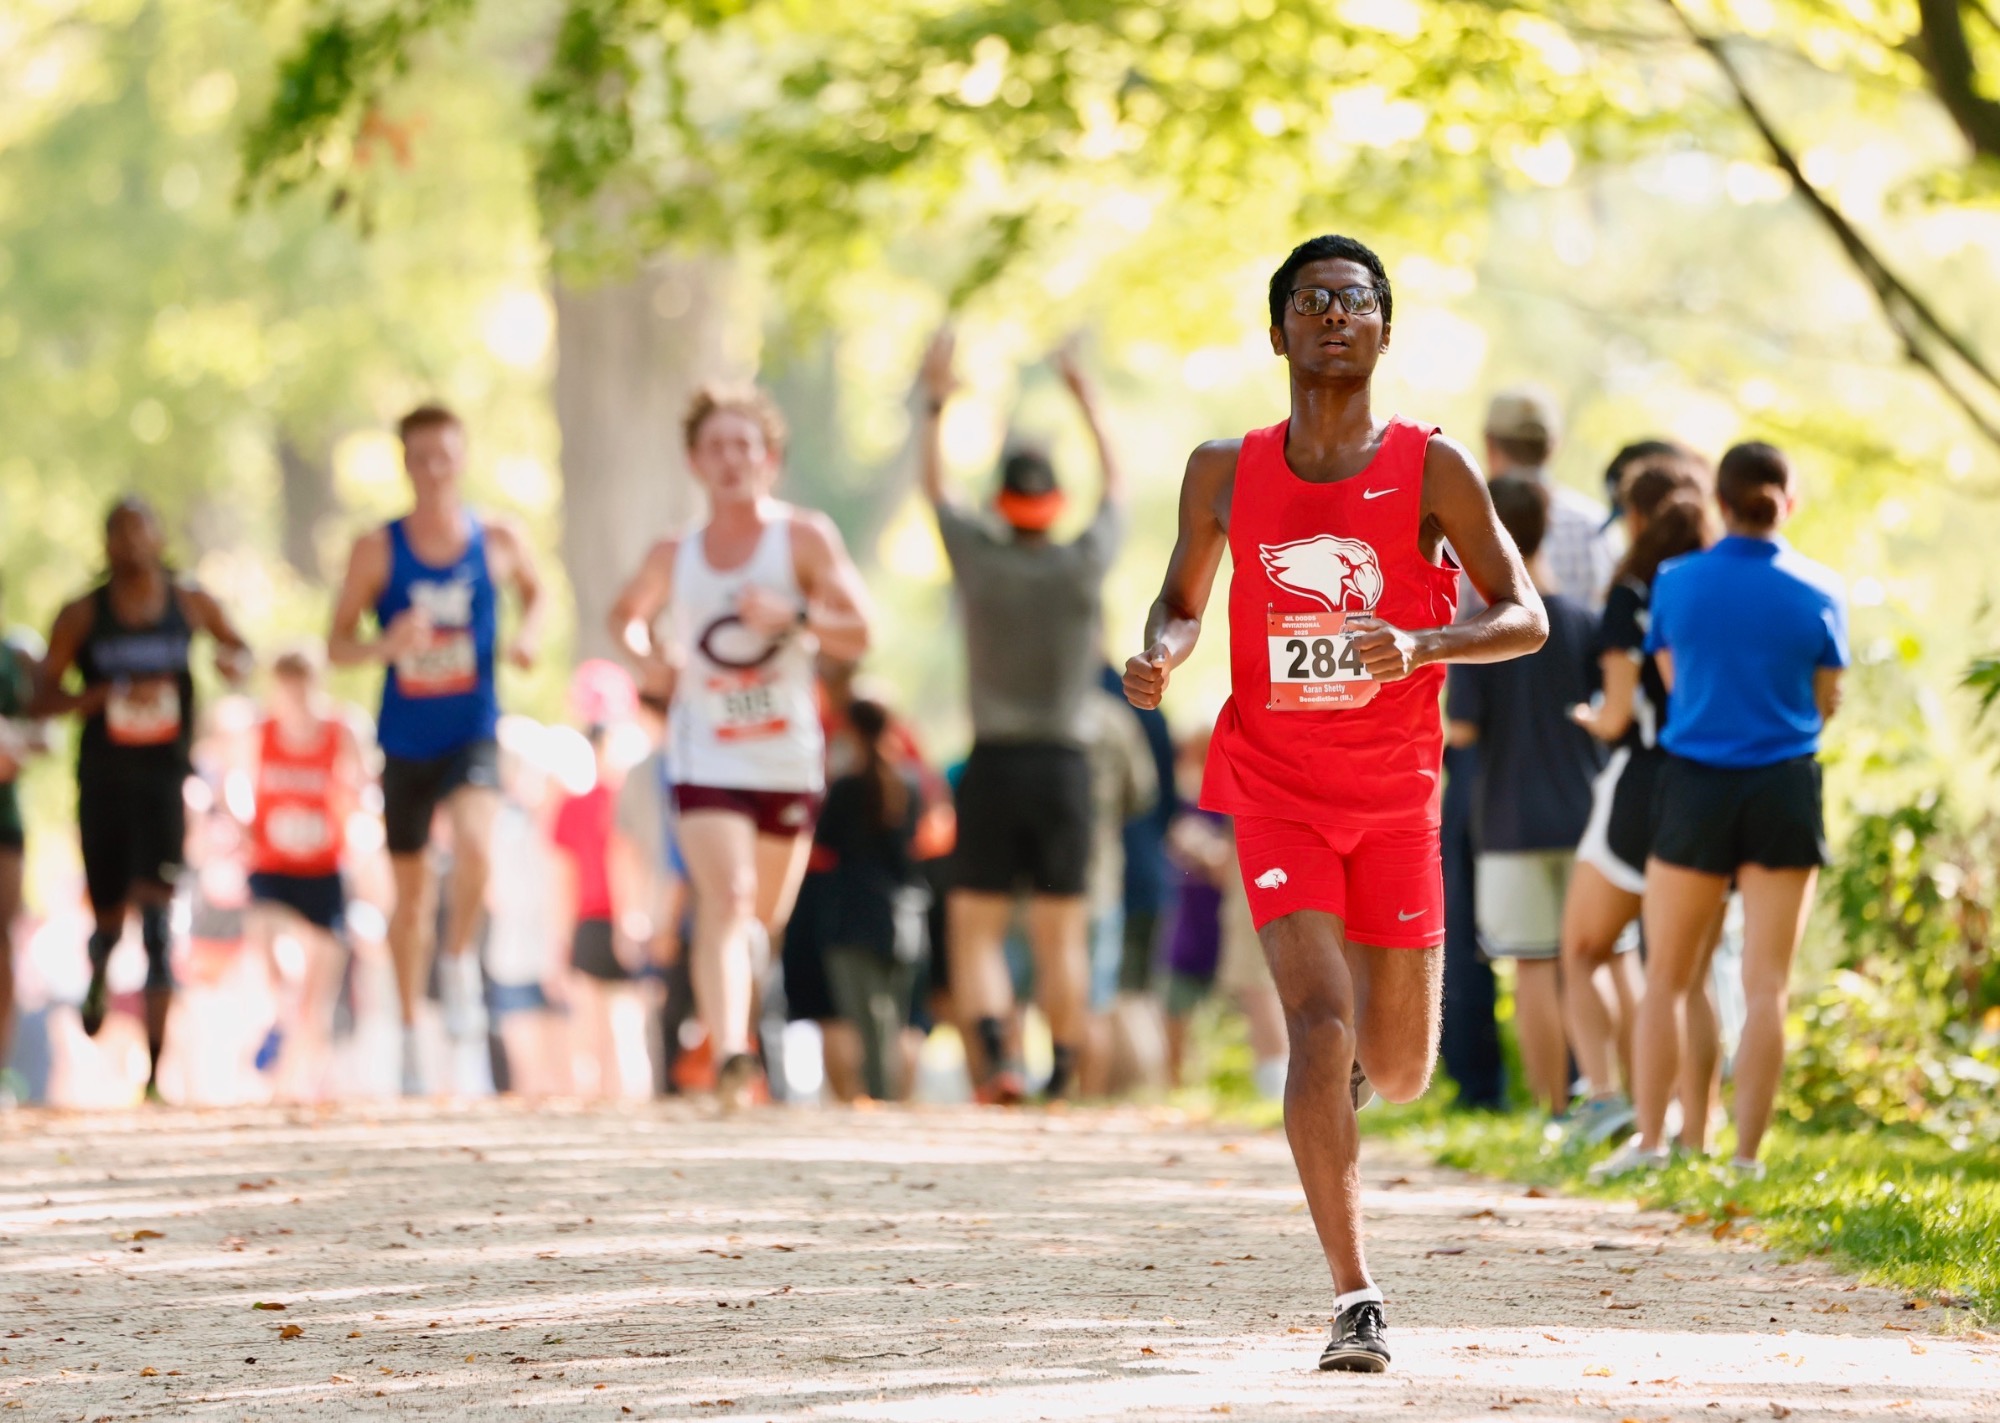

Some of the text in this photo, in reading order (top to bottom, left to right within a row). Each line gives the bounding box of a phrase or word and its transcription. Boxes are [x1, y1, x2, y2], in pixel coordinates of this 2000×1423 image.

[1281, 621, 1321, 629] INVITATIONAL
[1285, 638, 1364, 679] 284
[1302, 683, 1346, 694] Karan Shetty
[1299, 695, 1339, 703] Benedictine
